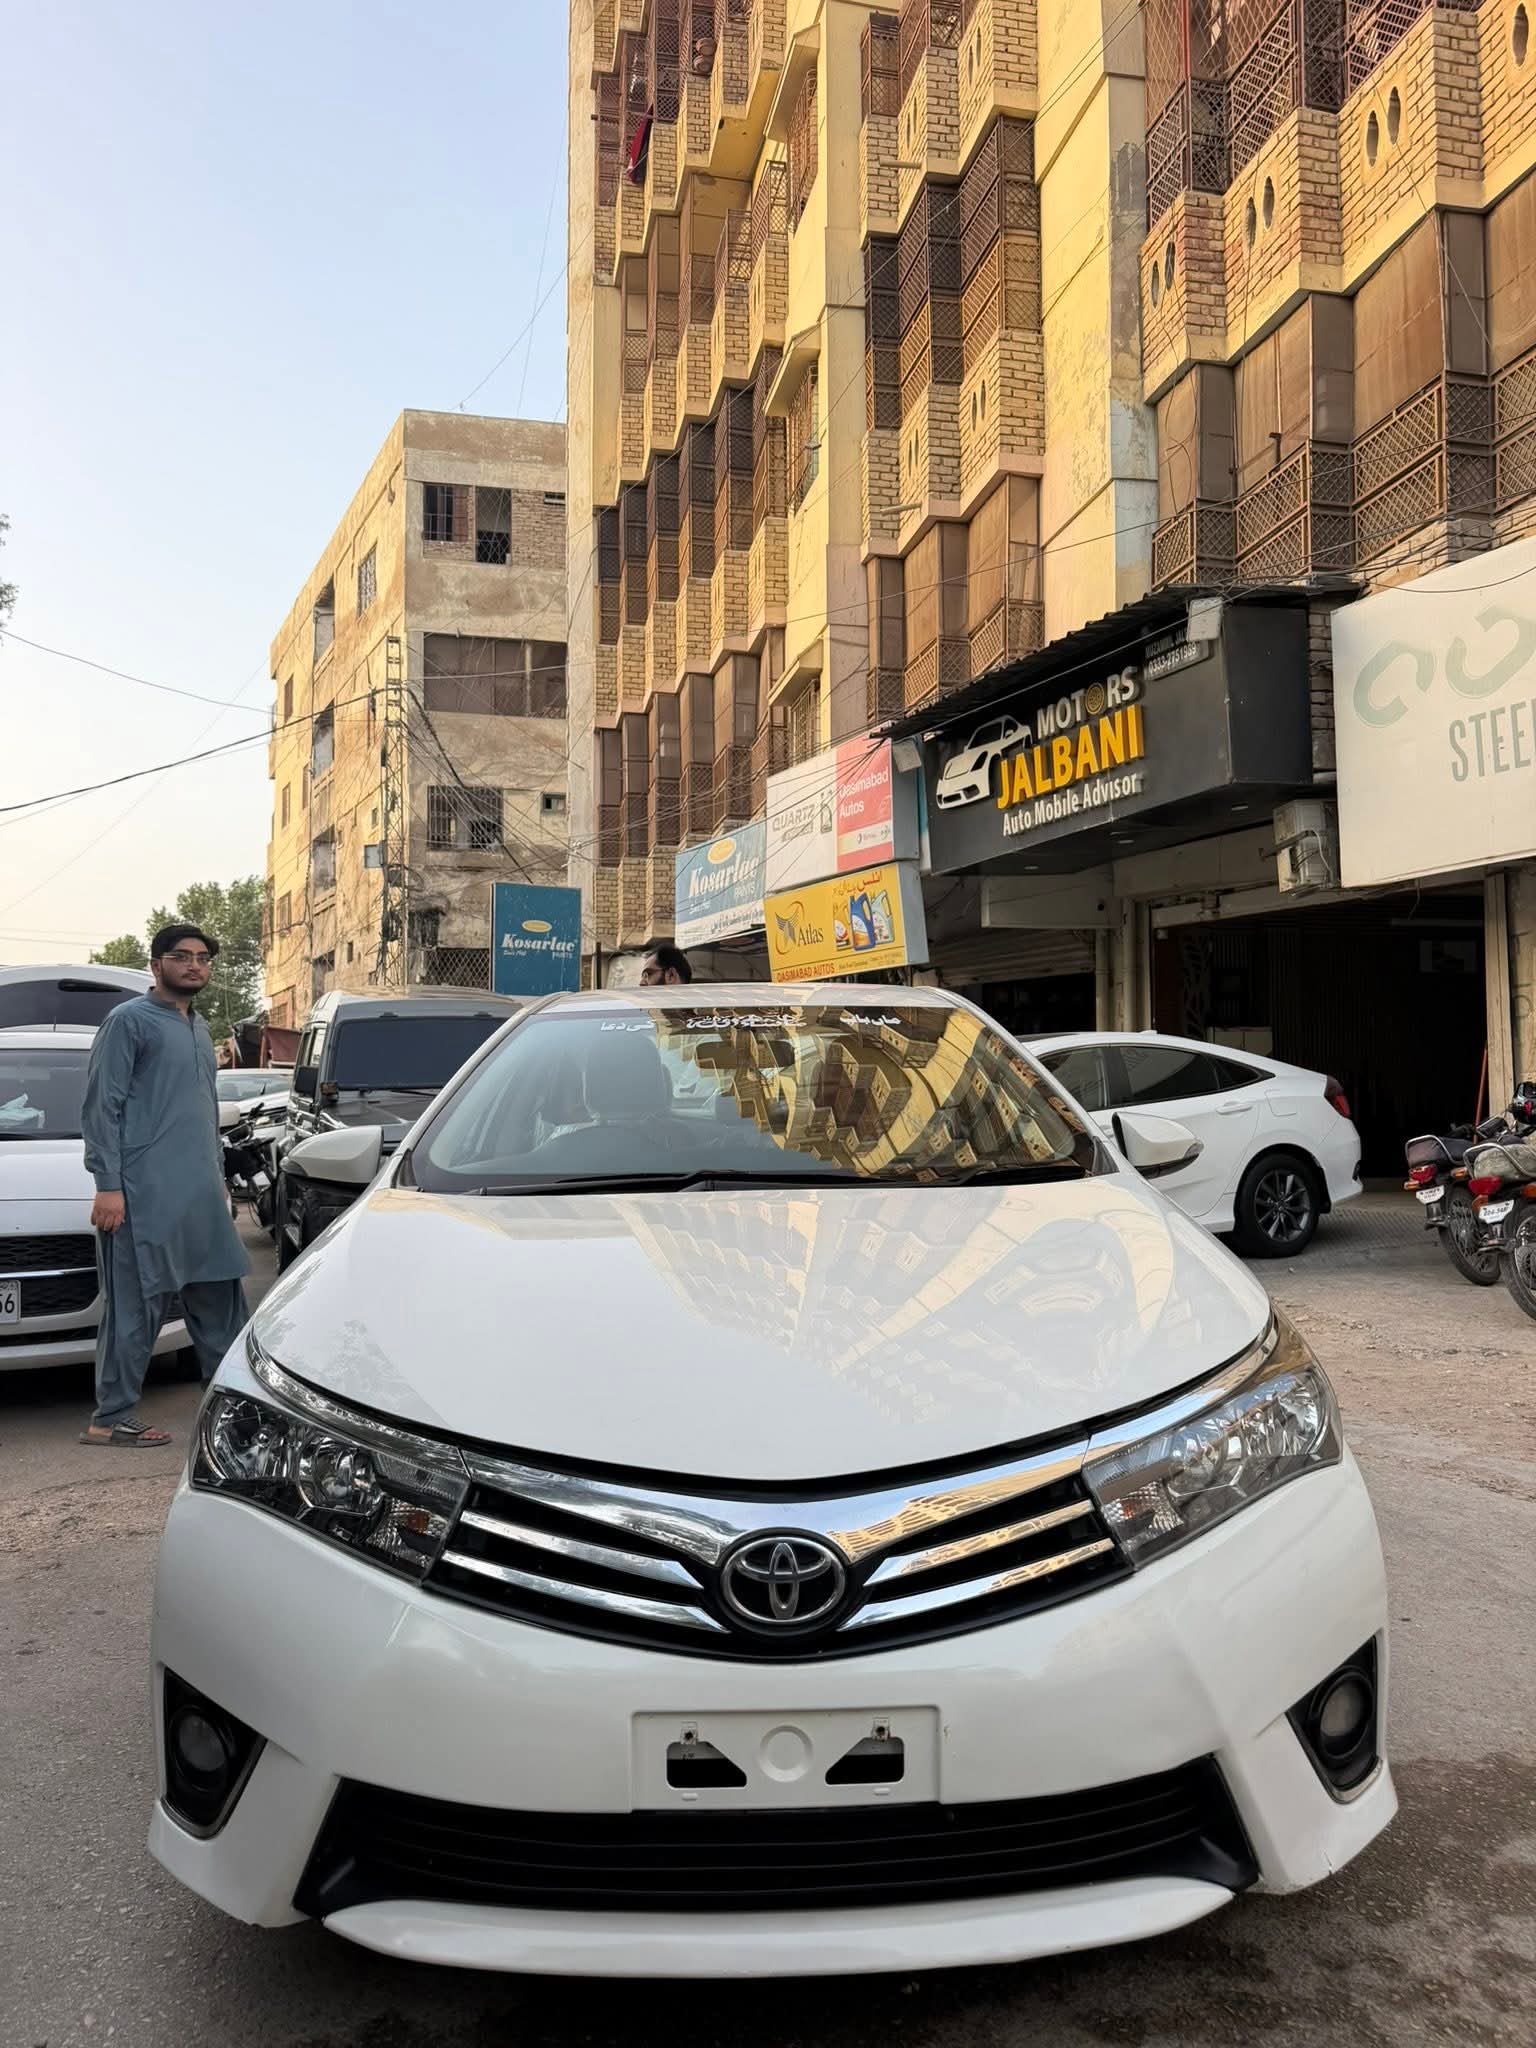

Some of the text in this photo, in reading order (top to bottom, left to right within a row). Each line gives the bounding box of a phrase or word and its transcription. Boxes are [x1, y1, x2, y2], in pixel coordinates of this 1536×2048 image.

[1037, 666, 1138, 739] MOTORS
[997, 704, 1142, 808] JALBANI
[1449, 699, 1536, 782] STEE
[840, 801, 865, 817] Autos
[1003, 773, 1137, 836] Auto Mobile Advisor
[501, 933, 576, 952] Kosarlac
[798, 924, 824, 947] Atlas
[814, 962, 836, 978] AUTOS
